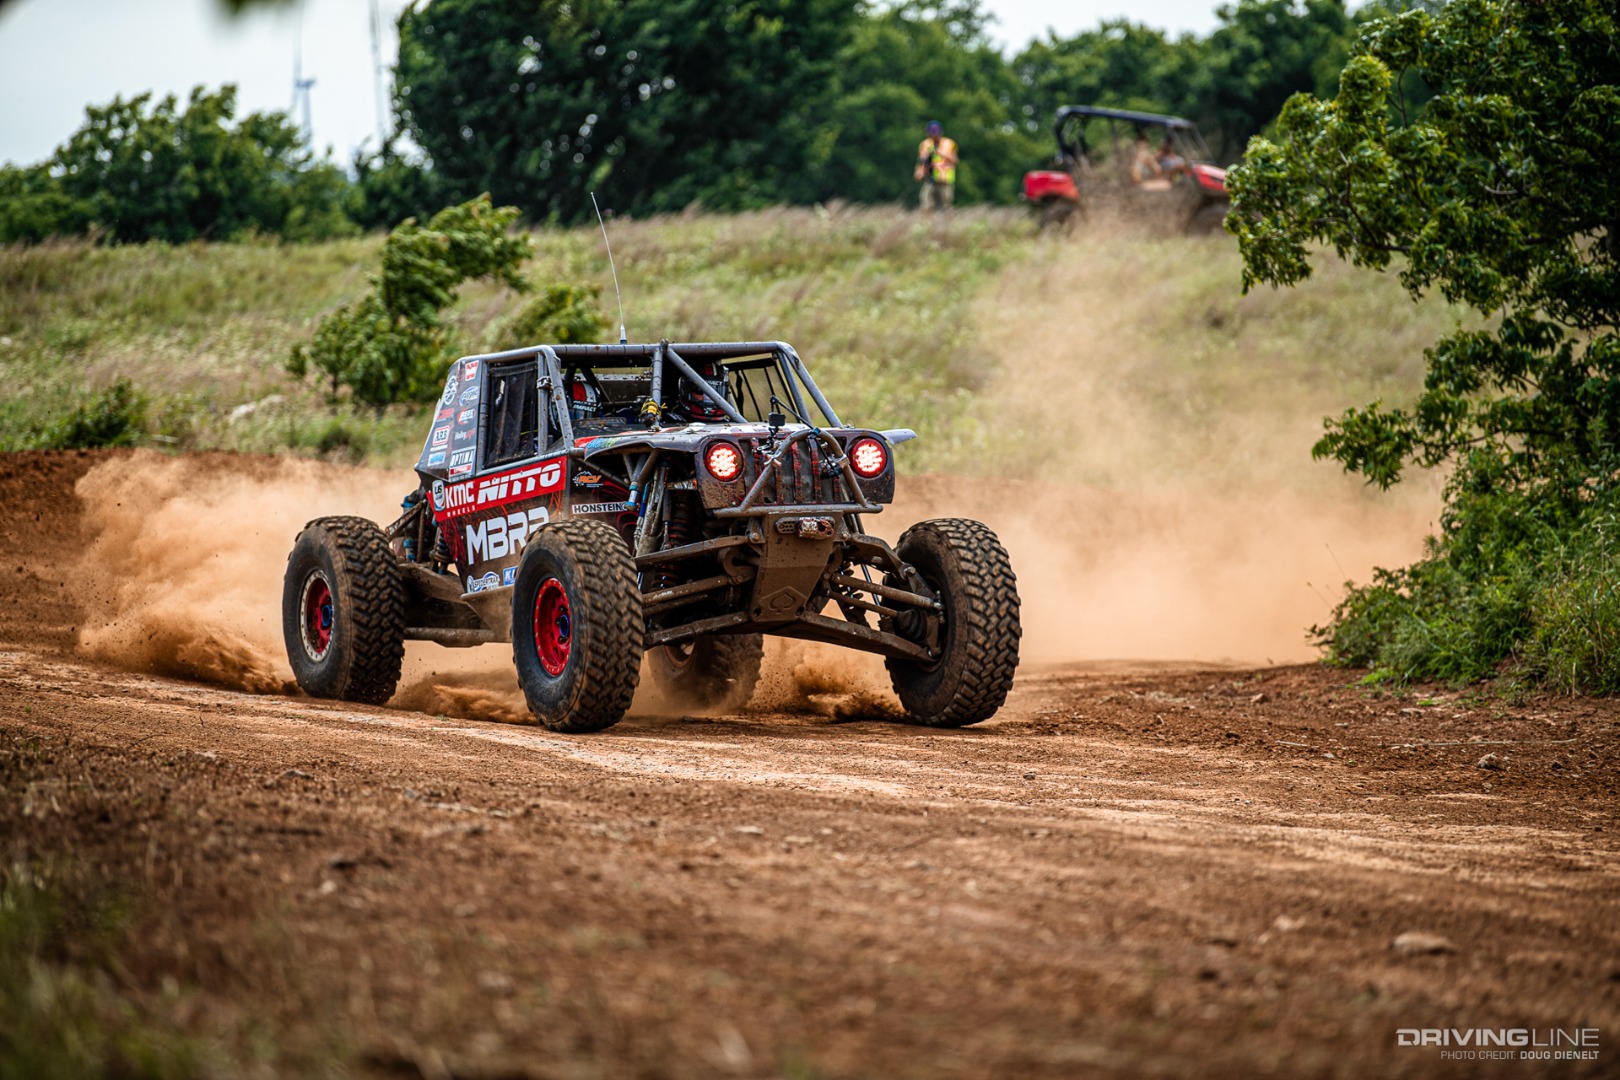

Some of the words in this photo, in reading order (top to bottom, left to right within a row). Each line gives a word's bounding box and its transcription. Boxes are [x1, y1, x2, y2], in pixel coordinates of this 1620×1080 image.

[573, 404, 597, 412] IMPACT
[450, 449, 473, 467] OPTIMA
[477, 463, 561, 504] NITTO
[447, 505, 476, 517] WHEELS
